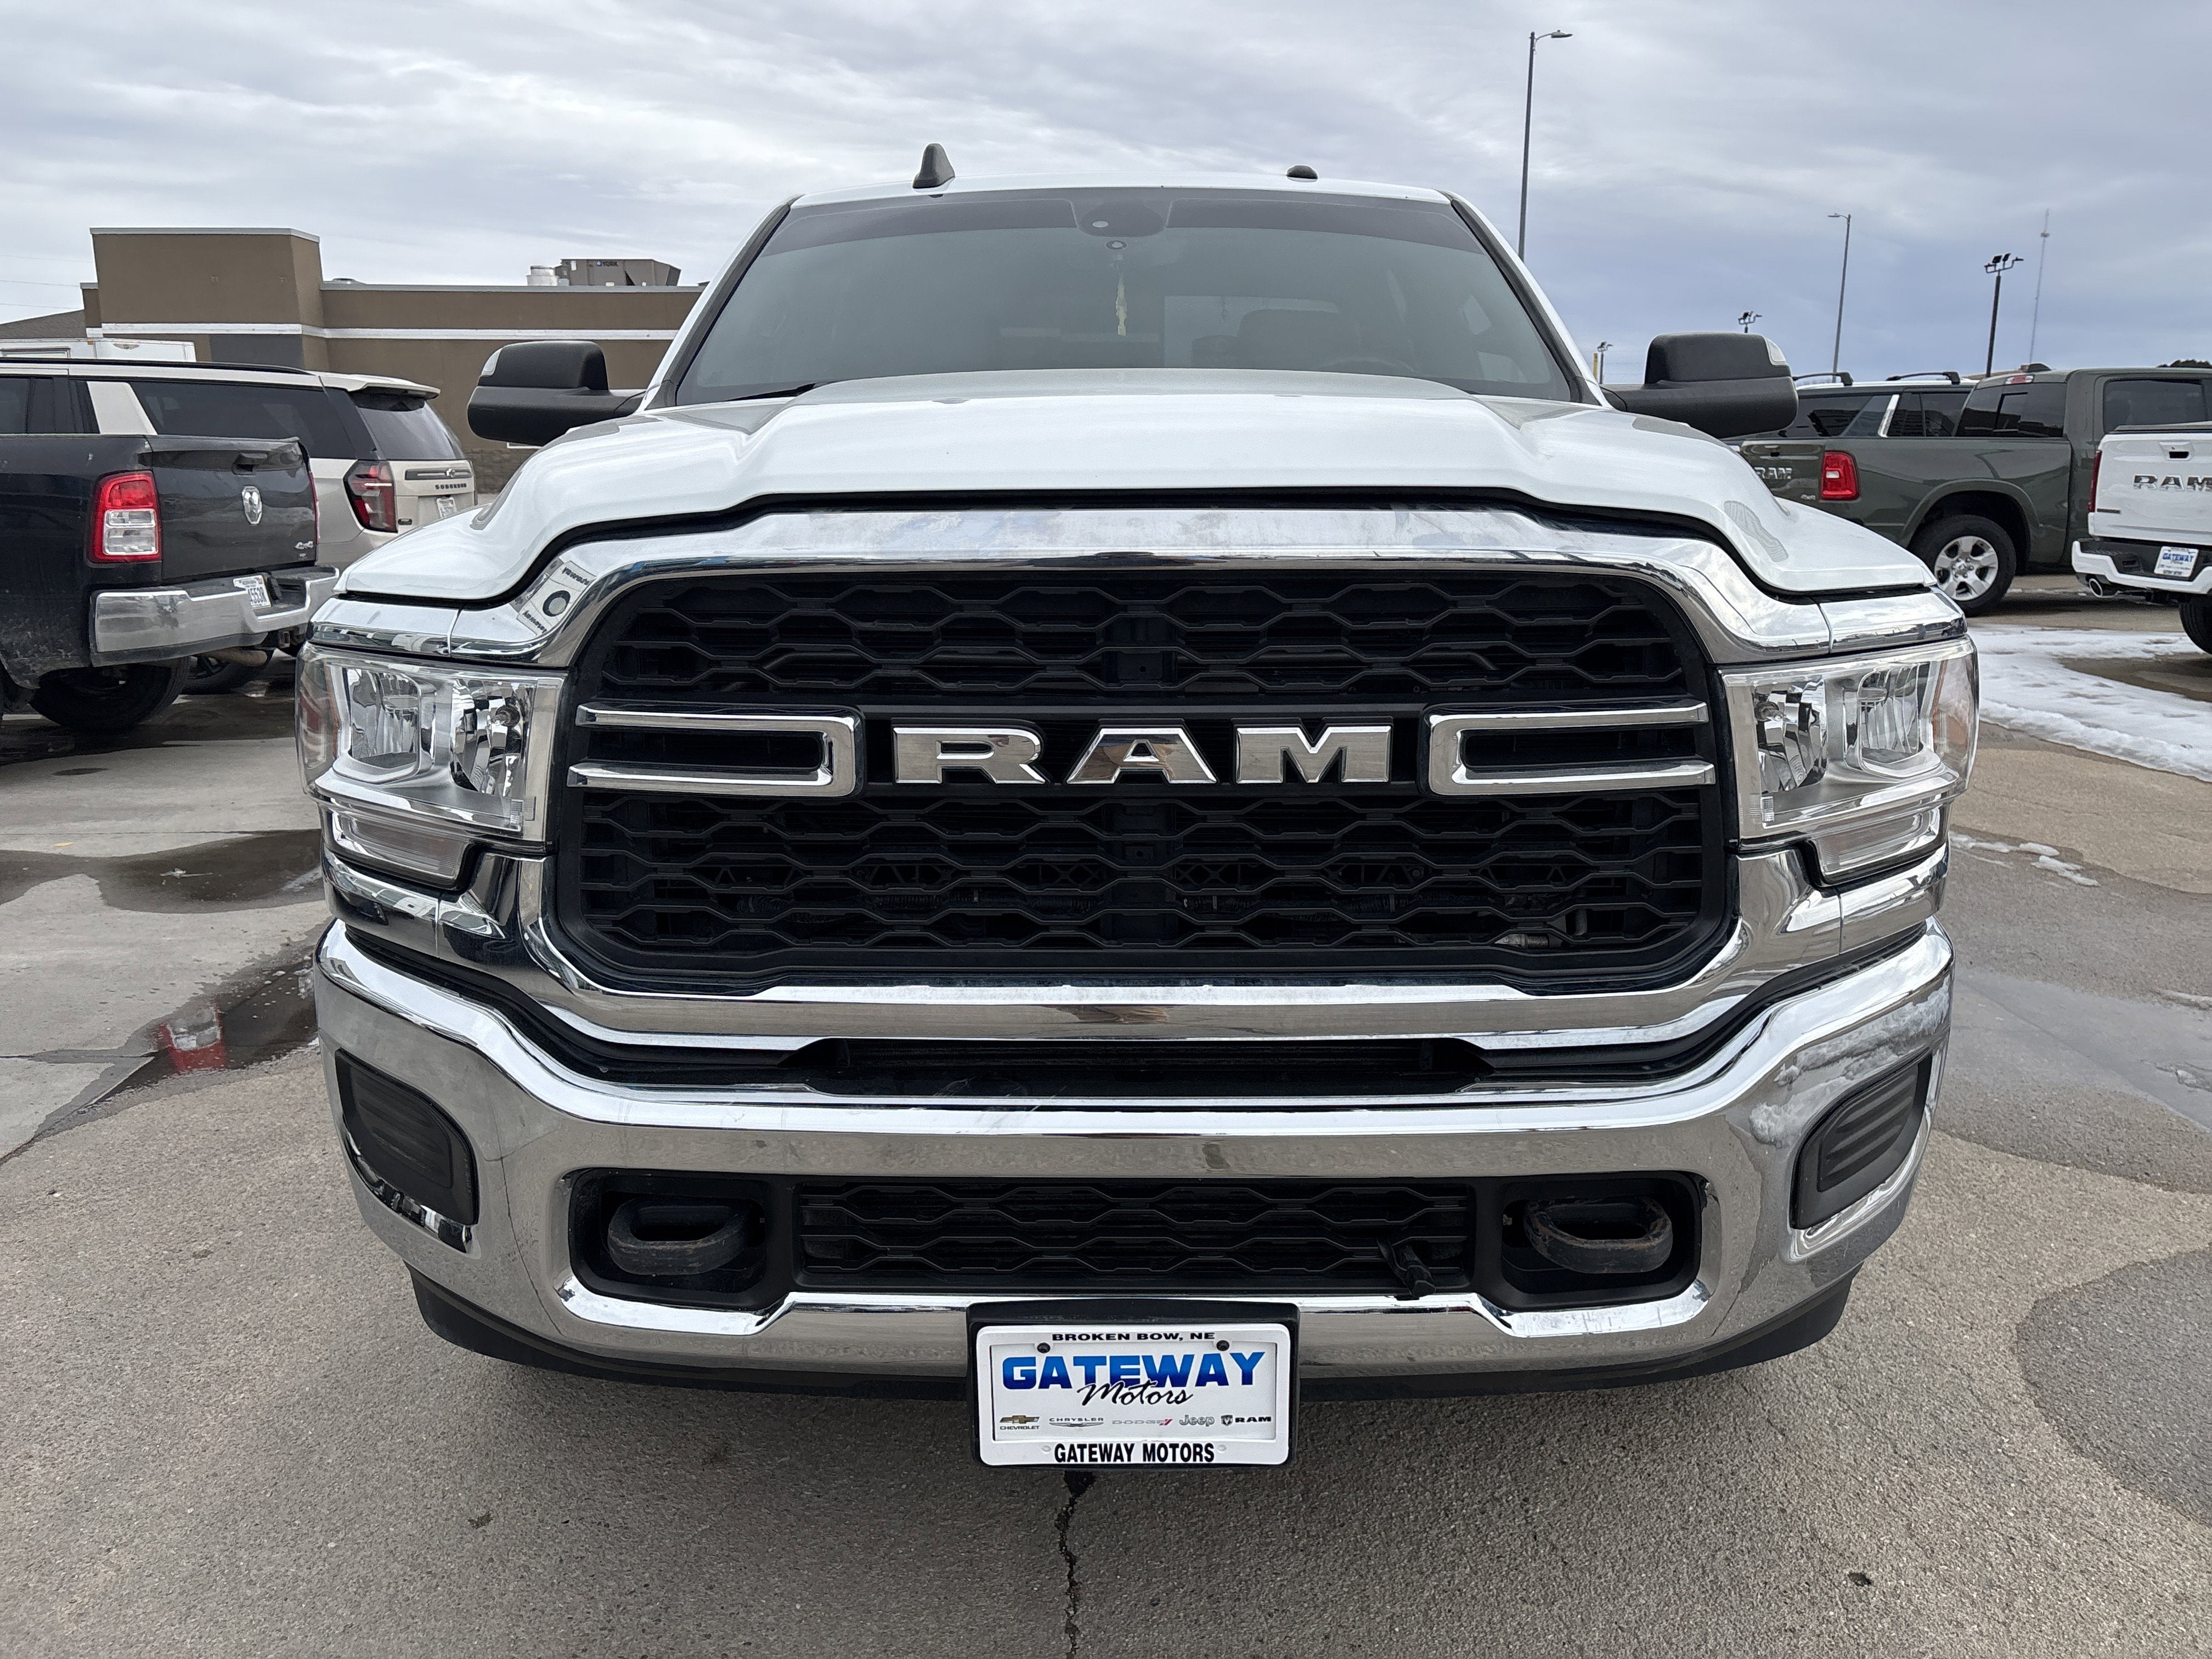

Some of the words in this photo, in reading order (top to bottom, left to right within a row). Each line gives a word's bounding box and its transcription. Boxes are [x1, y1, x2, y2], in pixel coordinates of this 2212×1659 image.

[1754, 466, 1792, 479] RAM
[2133, 474, 2212, 492] RAM
[893, 724, 1392, 785] RAM
[1051, 1333, 1130, 1341] BROKEN
[1136, 1332, 1184, 1341] BOW,
[1002, 1351, 1266, 1390] GATEWAY
[1076, 1379, 1194, 1406] Motors
[1178, 1414, 1215, 1427] Jeep
[1054, 1442, 1135, 1463] GATEWAY
[1142, 1442, 1215, 1463] MOTORS
